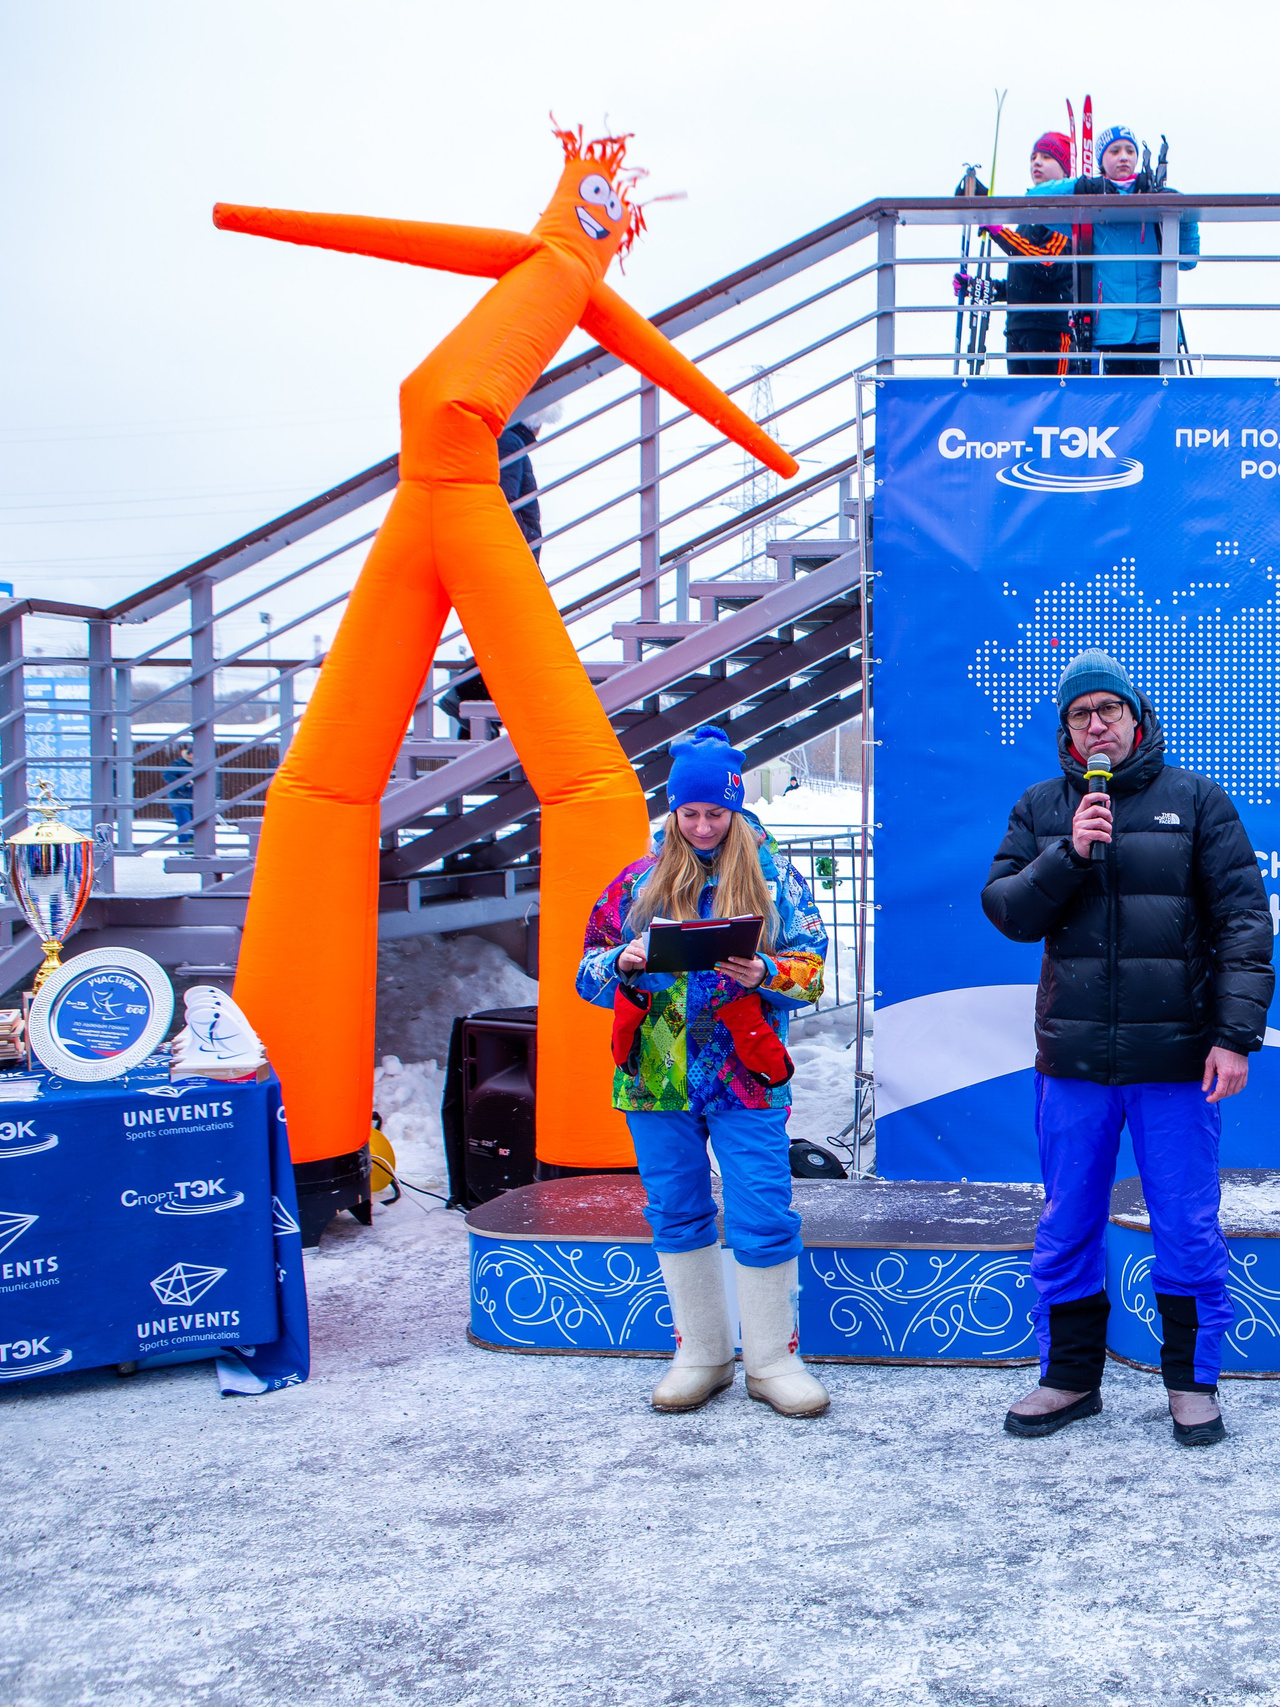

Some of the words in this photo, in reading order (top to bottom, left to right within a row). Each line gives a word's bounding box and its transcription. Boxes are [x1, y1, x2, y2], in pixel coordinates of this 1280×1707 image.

[1175, 428, 1230, 448] ПРИ
[723, 787, 739, 802] SKI
[87, 975, 139, 992] УЧАСТНИК
[123, 1101, 233, 1127] UNEVENTS
[125, 1129, 157, 1141] Sports
[158, 1121, 234, 1136] communications
[137, 1310, 240, 1339] UNEVENTS
[139, 1338, 169, 1352] Sports
[171, 1330, 240, 1344] communications
